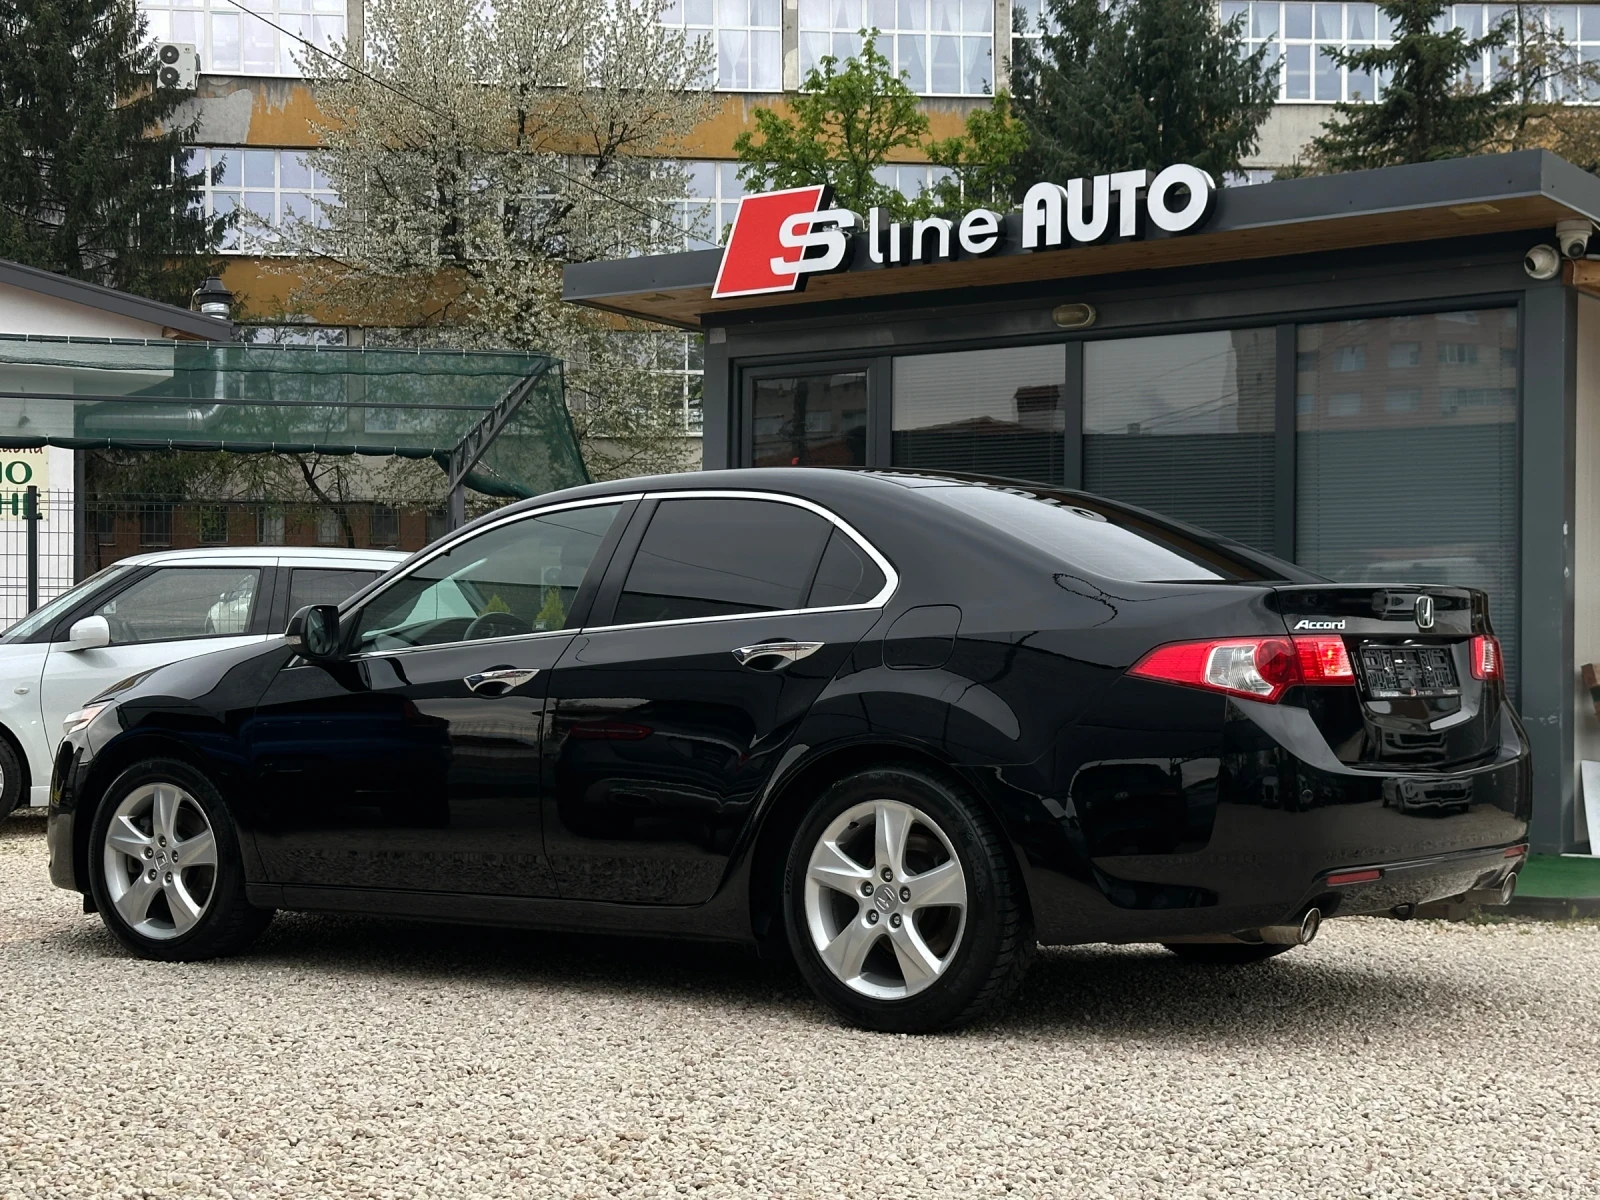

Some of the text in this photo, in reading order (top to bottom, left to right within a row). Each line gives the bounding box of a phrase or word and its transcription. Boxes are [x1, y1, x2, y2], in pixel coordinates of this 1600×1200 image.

[769, 163, 1210, 275] S line AUTO
[0, 460, 33, 485] O
[1293, 619, 1346, 630] Accord
